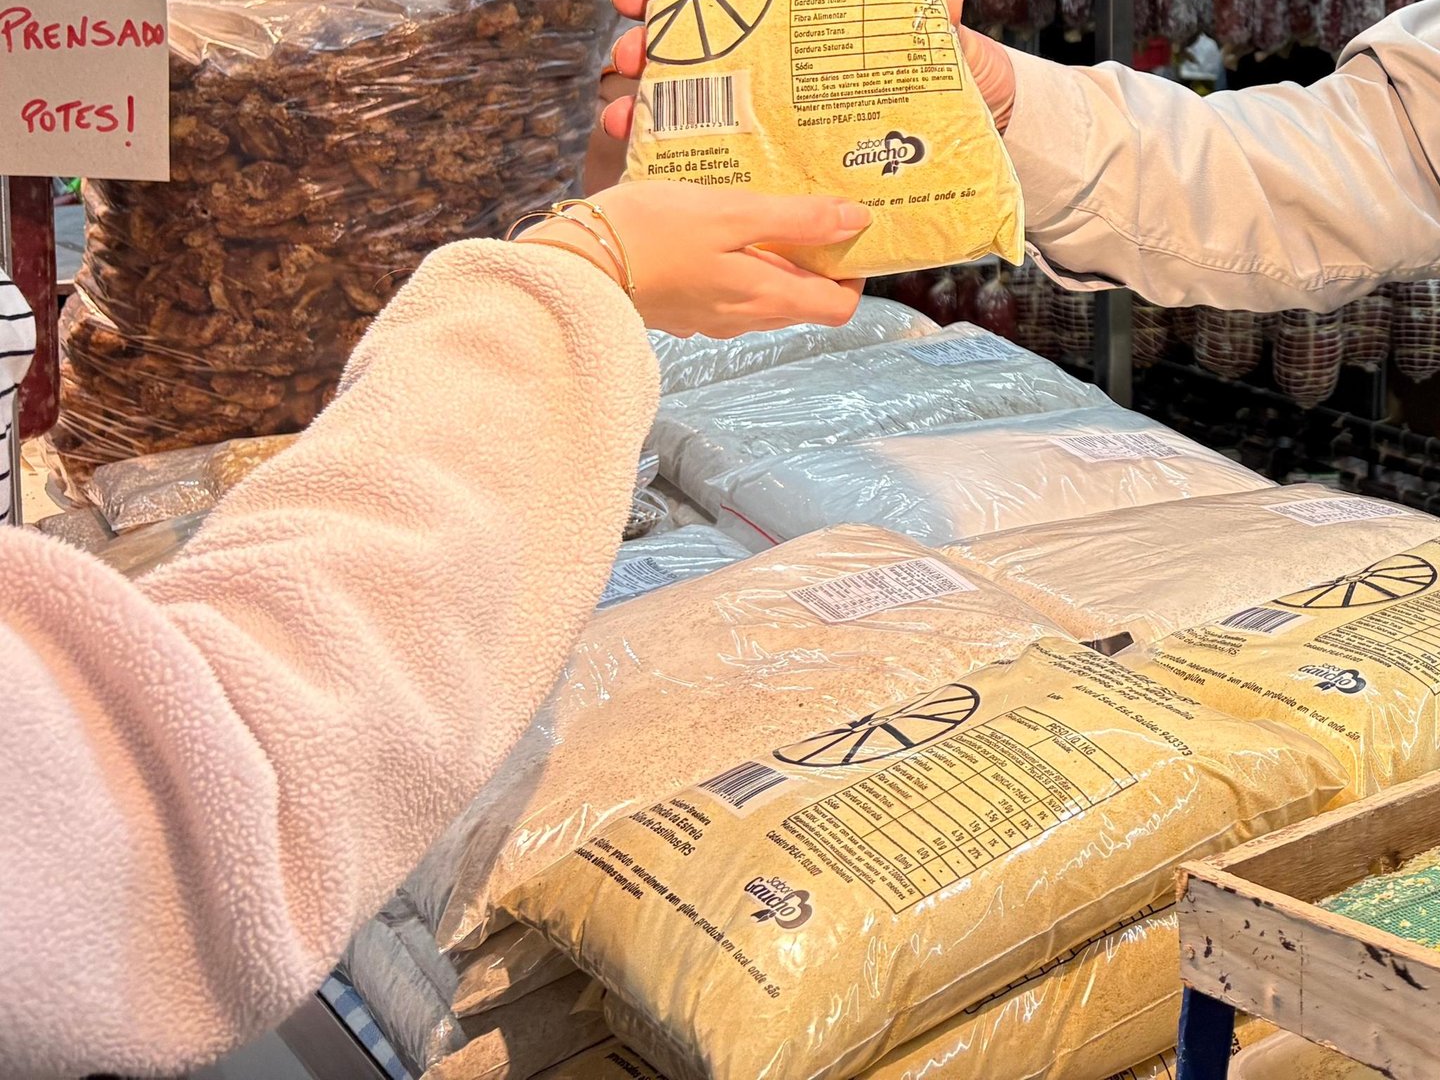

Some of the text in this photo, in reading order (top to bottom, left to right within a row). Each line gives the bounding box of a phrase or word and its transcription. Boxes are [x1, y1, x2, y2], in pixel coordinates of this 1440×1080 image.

[794, 11, 847, 22] Fibra Alimentar
[0, 6, 165, 53] PRENSADO
[794, 29, 825, 38] Gorduras
[794, 42, 853, 55] Gordura Saturada
[795, 62, 813, 71] Sódio
[833, 100, 876, 110] temperatura
[877, 96, 909, 105] Ambiente
[21, 95, 135, 148] POTES!
[797, 116, 831, 127] Cadastro
[856, 138, 884, 151] Sabor
[656, 146, 729, 160] Indústria Brasileira
[843, 146, 908, 167] Gaúcho
[648, 158, 739, 175] Rincão da Estrela
[909, 193, 930, 204] local
[934, 190, 956, 200] onde
[960, 188, 976, 198] são
[1228, 676, 1361, 741] sem produzido em local onde são
[1045, 722, 1068, 738] PESO
[1130, 713, 1193, 757] Saúde: 943373
[988, 753, 1008, 768] porção
[668, 813, 703, 841] da Estrela
[1019, 818, 1032, 831] 13%
[642, 818, 696, 856] de Castilhos/RS
[1004, 828, 1017, 838] 5%
[987, 838, 999, 848] 1%
[967, 847, 983, 860] 27%
[766, 876, 793, 894] Sabor
[744, 876, 796, 916] Gaúcho
[665, 892, 681, 907] sem
[721, 940, 735, 952] em
[732, 949, 753, 967] local
[748, 966, 767, 984] onde
[764, 983, 780, 999] são
